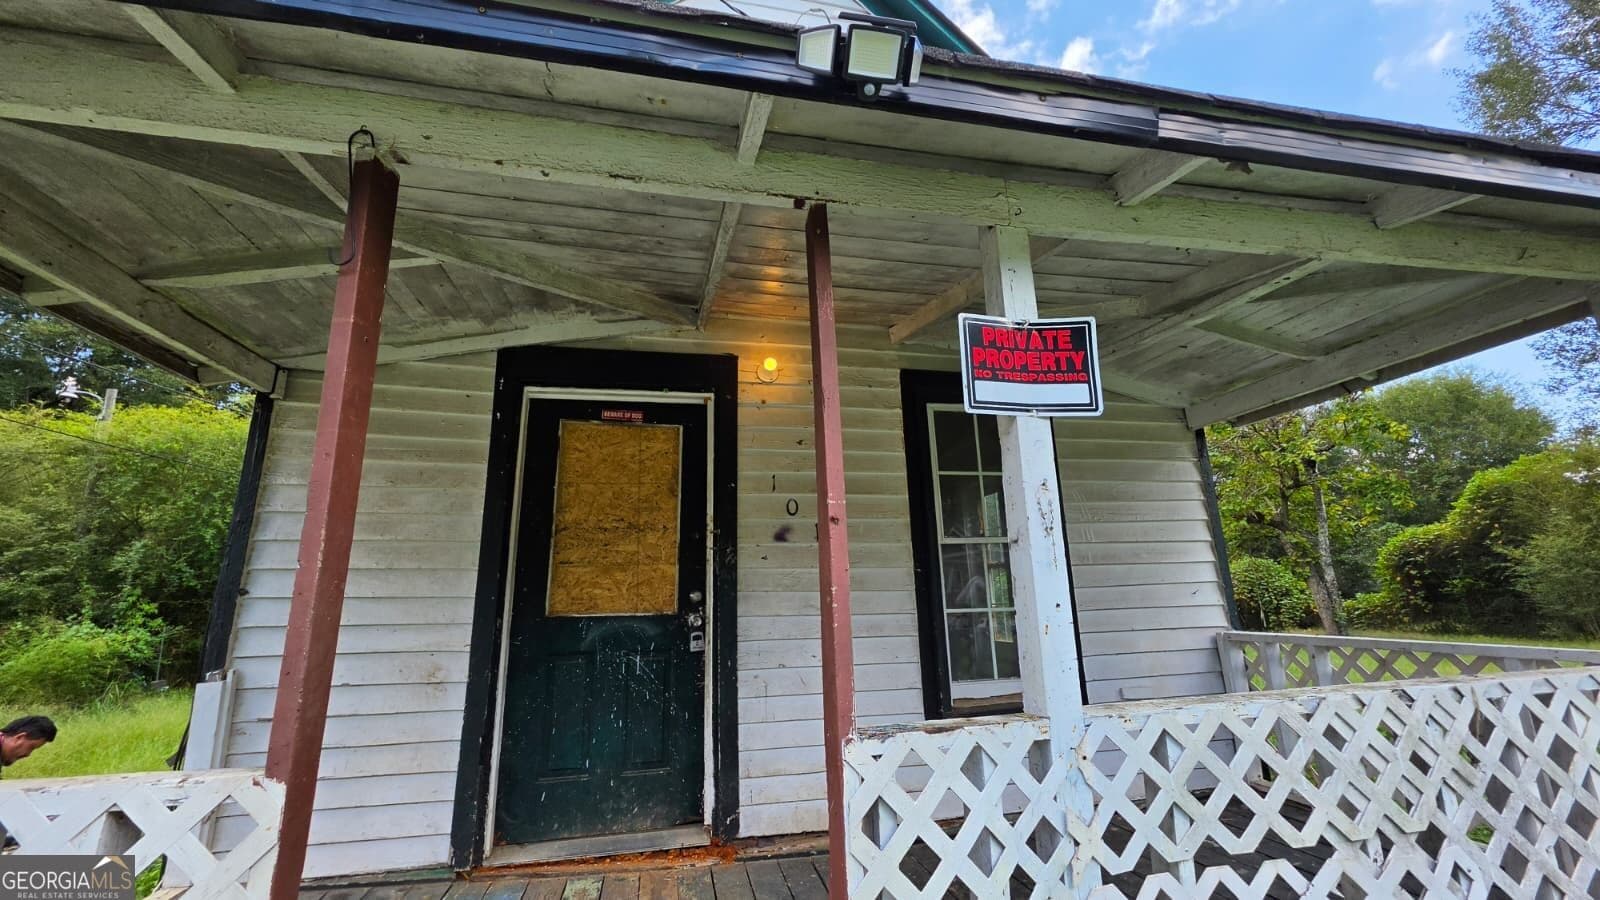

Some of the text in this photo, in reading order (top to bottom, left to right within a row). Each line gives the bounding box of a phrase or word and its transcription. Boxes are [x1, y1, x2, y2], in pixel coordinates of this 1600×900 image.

[982, 326, 1073, 349] PRIVATE
[972, 347, 1085, 371] PROPERTY
[974, 369, 1088, 382] NO TRESPASSING
